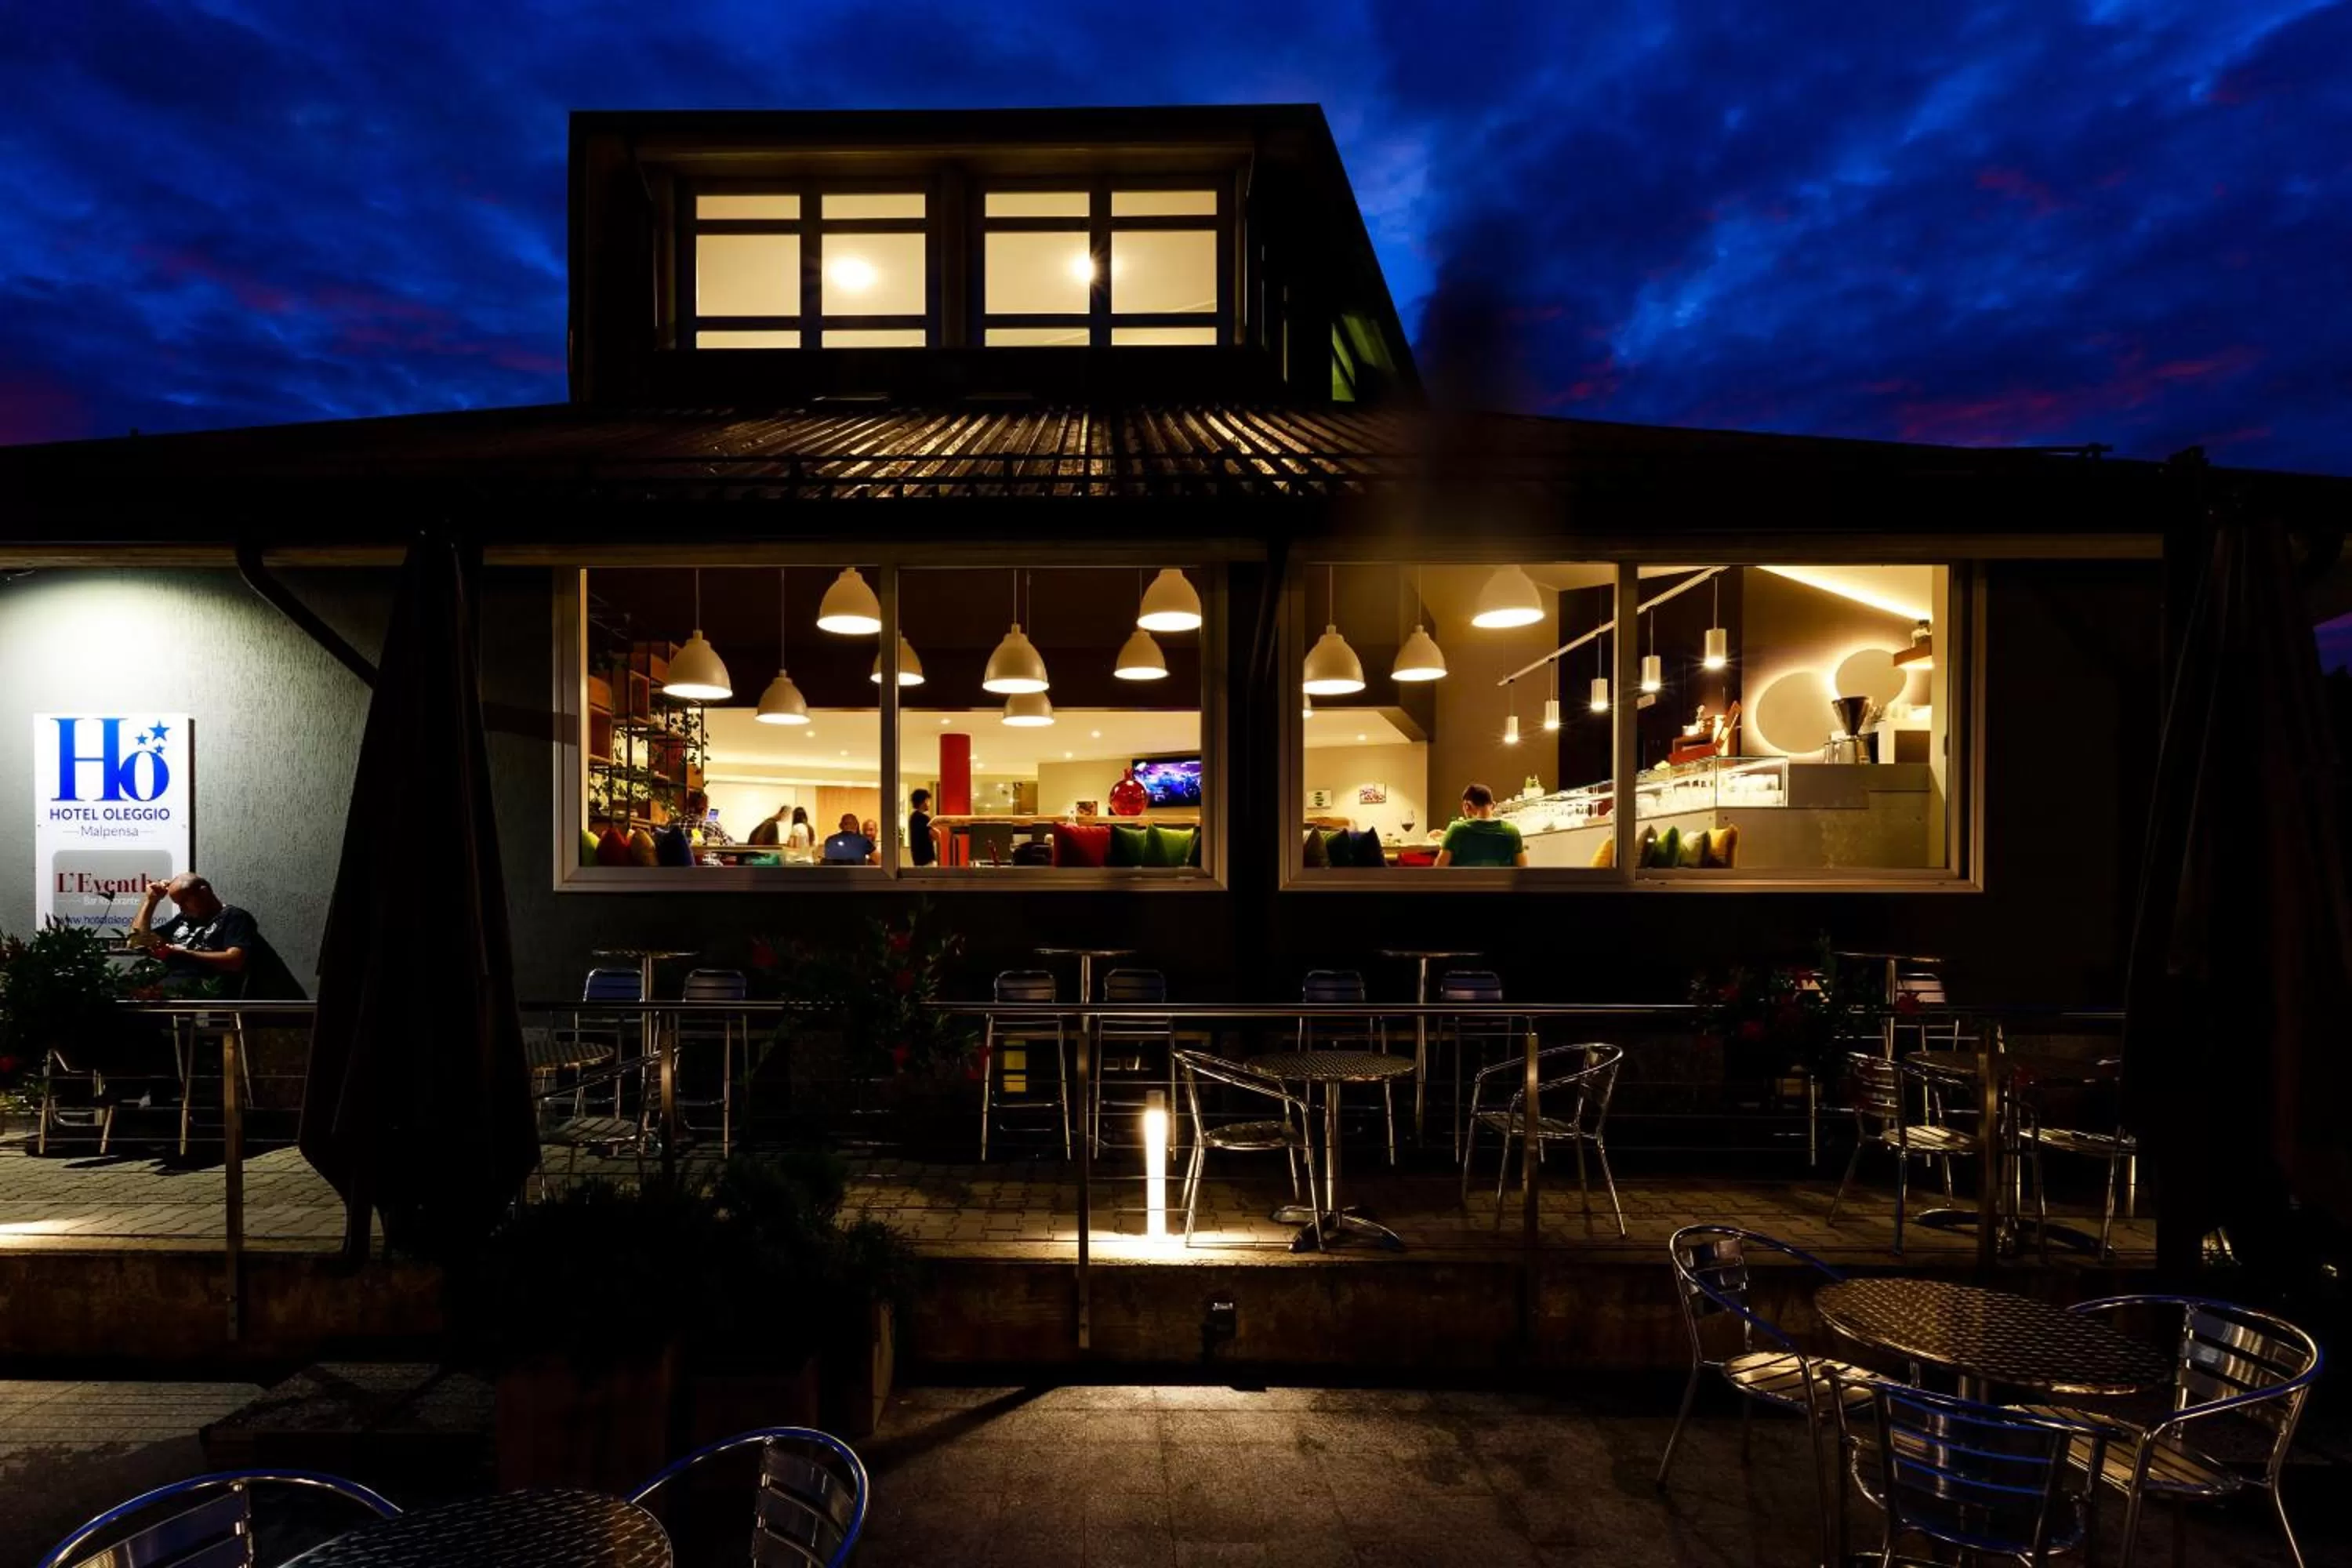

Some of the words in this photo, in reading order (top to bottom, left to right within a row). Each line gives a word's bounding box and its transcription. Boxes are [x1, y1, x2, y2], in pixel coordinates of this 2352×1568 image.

[49, 808, 99, 821] HOTEL
[103, 808, 170, 821] OLEGGIO
[81, 826, 139, 838] Malpensa
